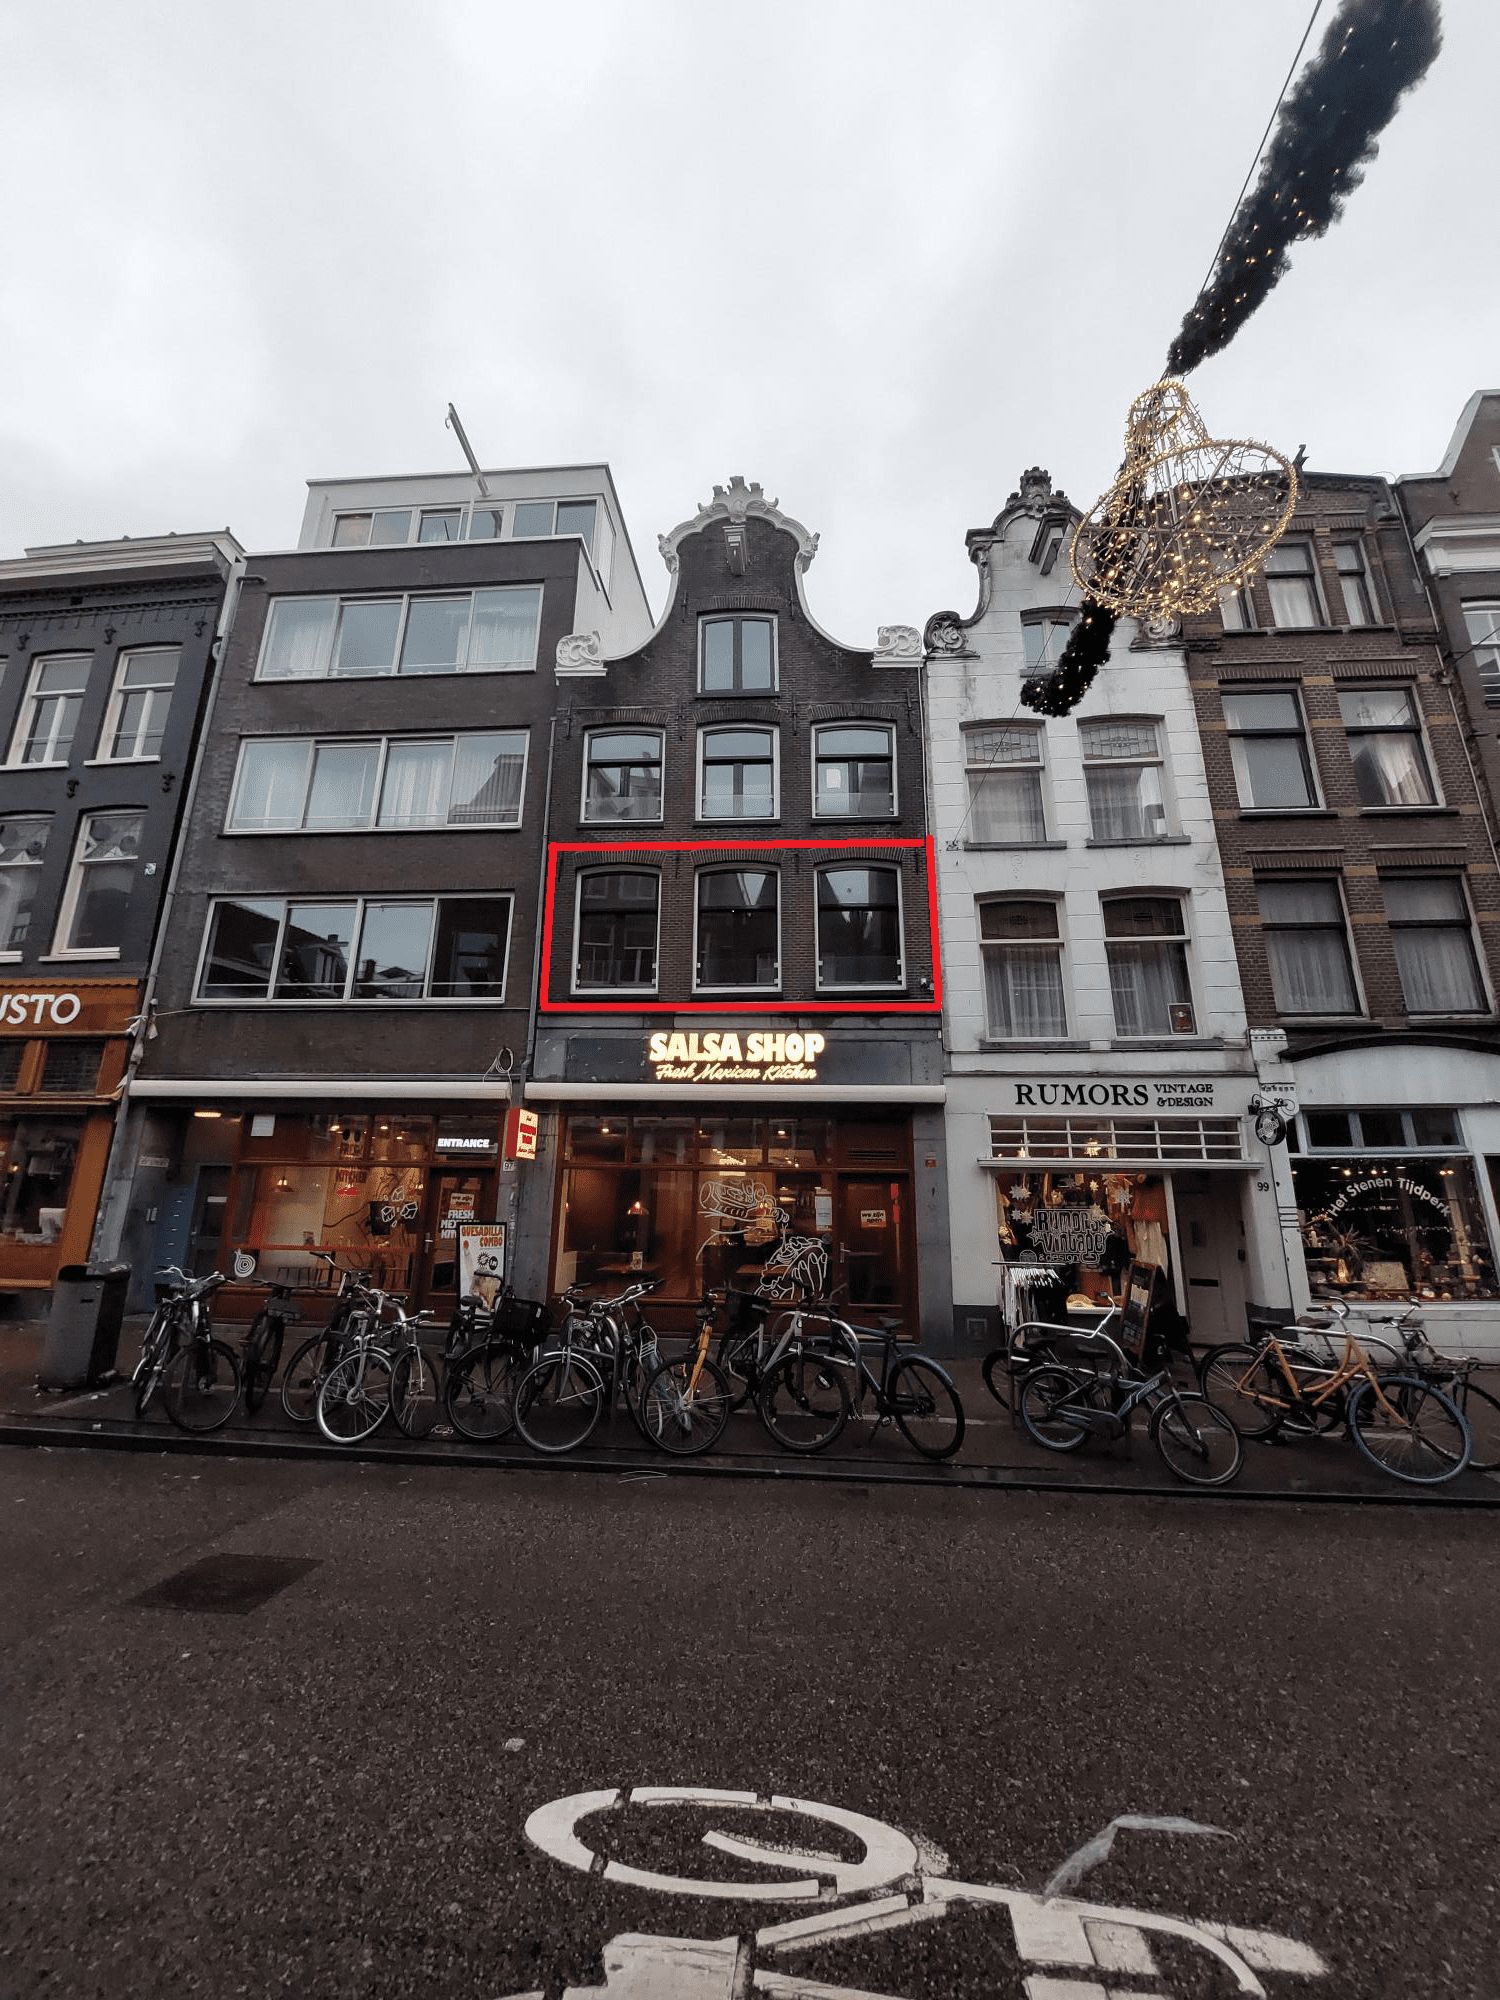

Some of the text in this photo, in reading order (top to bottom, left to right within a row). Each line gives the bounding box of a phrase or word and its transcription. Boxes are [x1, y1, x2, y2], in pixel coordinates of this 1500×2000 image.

[649, 1032, 825, 1062] SALSA SHOP
[655, 1062, 818, 1082] Fresh Mexican Kitchen
[1014, 1084, 1214, 1106] RUMORS VINTAGE
[437, 1138, 490, 1148] ENTRANCE
[504, 1162, 514, 1170] 97
[1257, 1182, 1270, 1192] 99
[1327, 1177, 1452, 1217] Het Stenen Tijdperk
[447, 1210, 475, 1219] FRESH
[461, 1226, 503, 1237] QUESADILLA
[479, 1237, 503, 1248] COMBO
